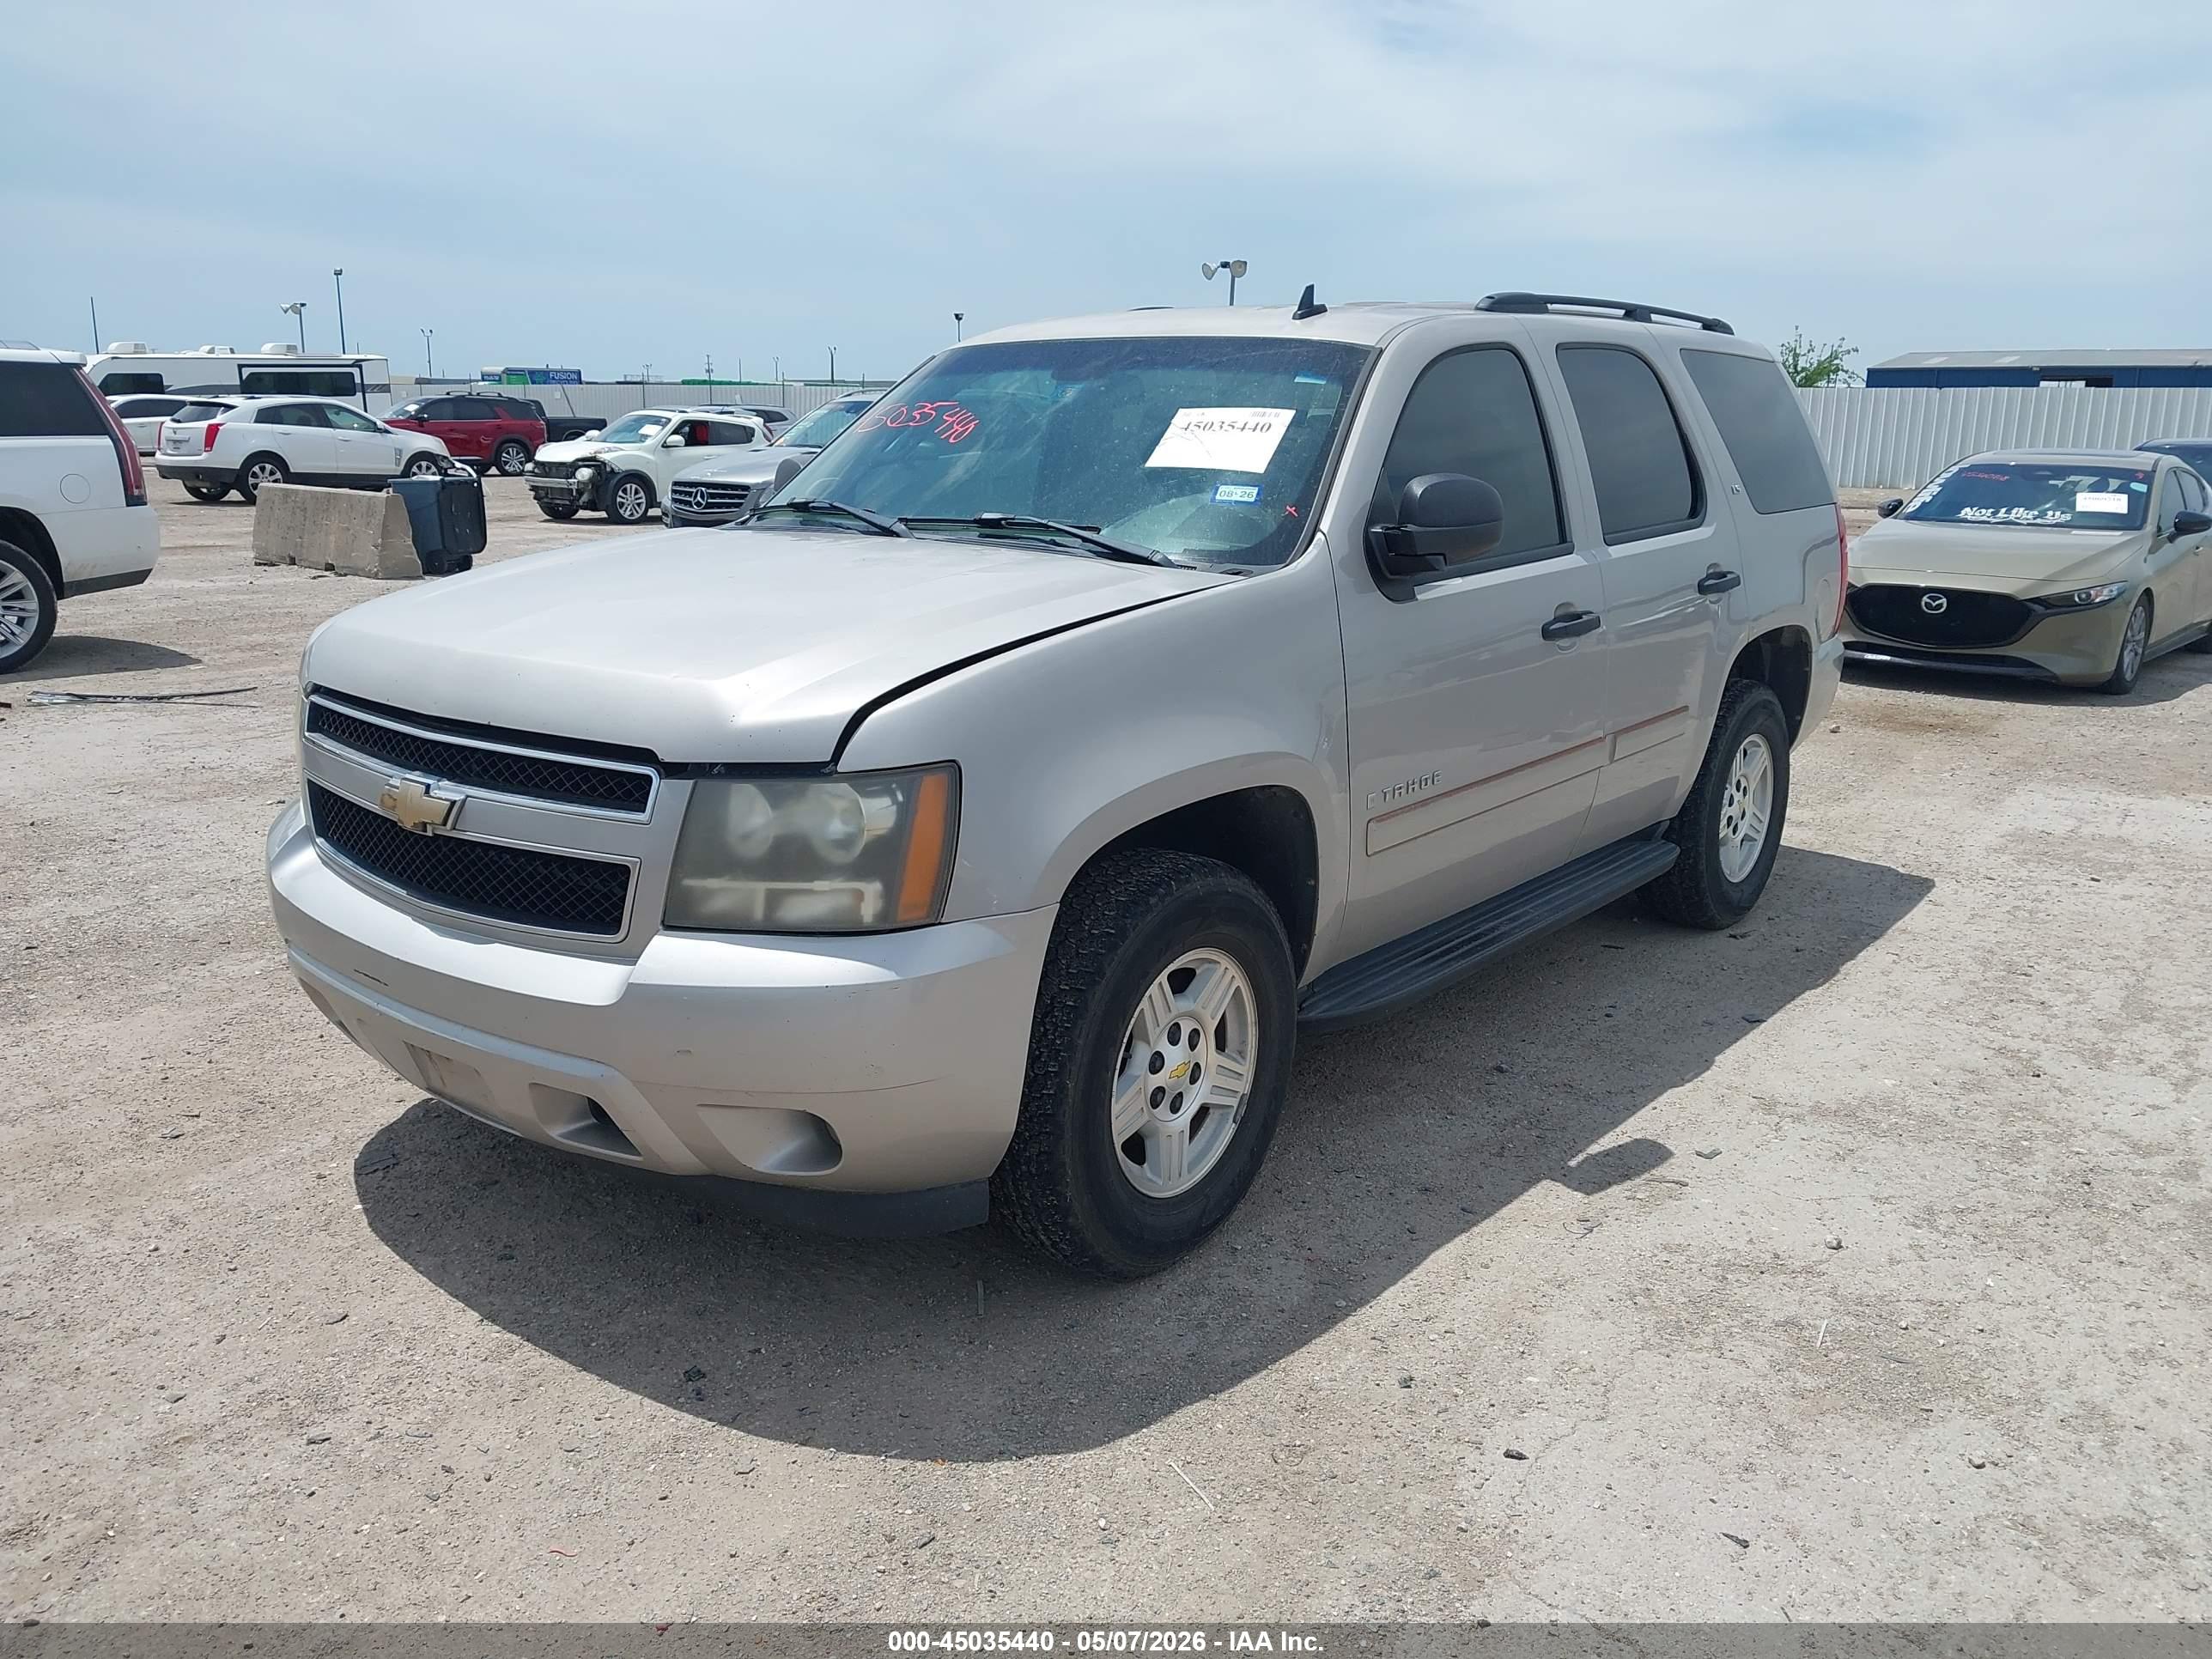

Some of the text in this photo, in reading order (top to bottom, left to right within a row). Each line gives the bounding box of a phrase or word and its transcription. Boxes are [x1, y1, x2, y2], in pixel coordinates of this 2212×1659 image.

[550, 371, 578, 380] FUSION
[1180, 421, 1273, 433] 45035440
[1382, 769, 1443, 803] TAHOE
